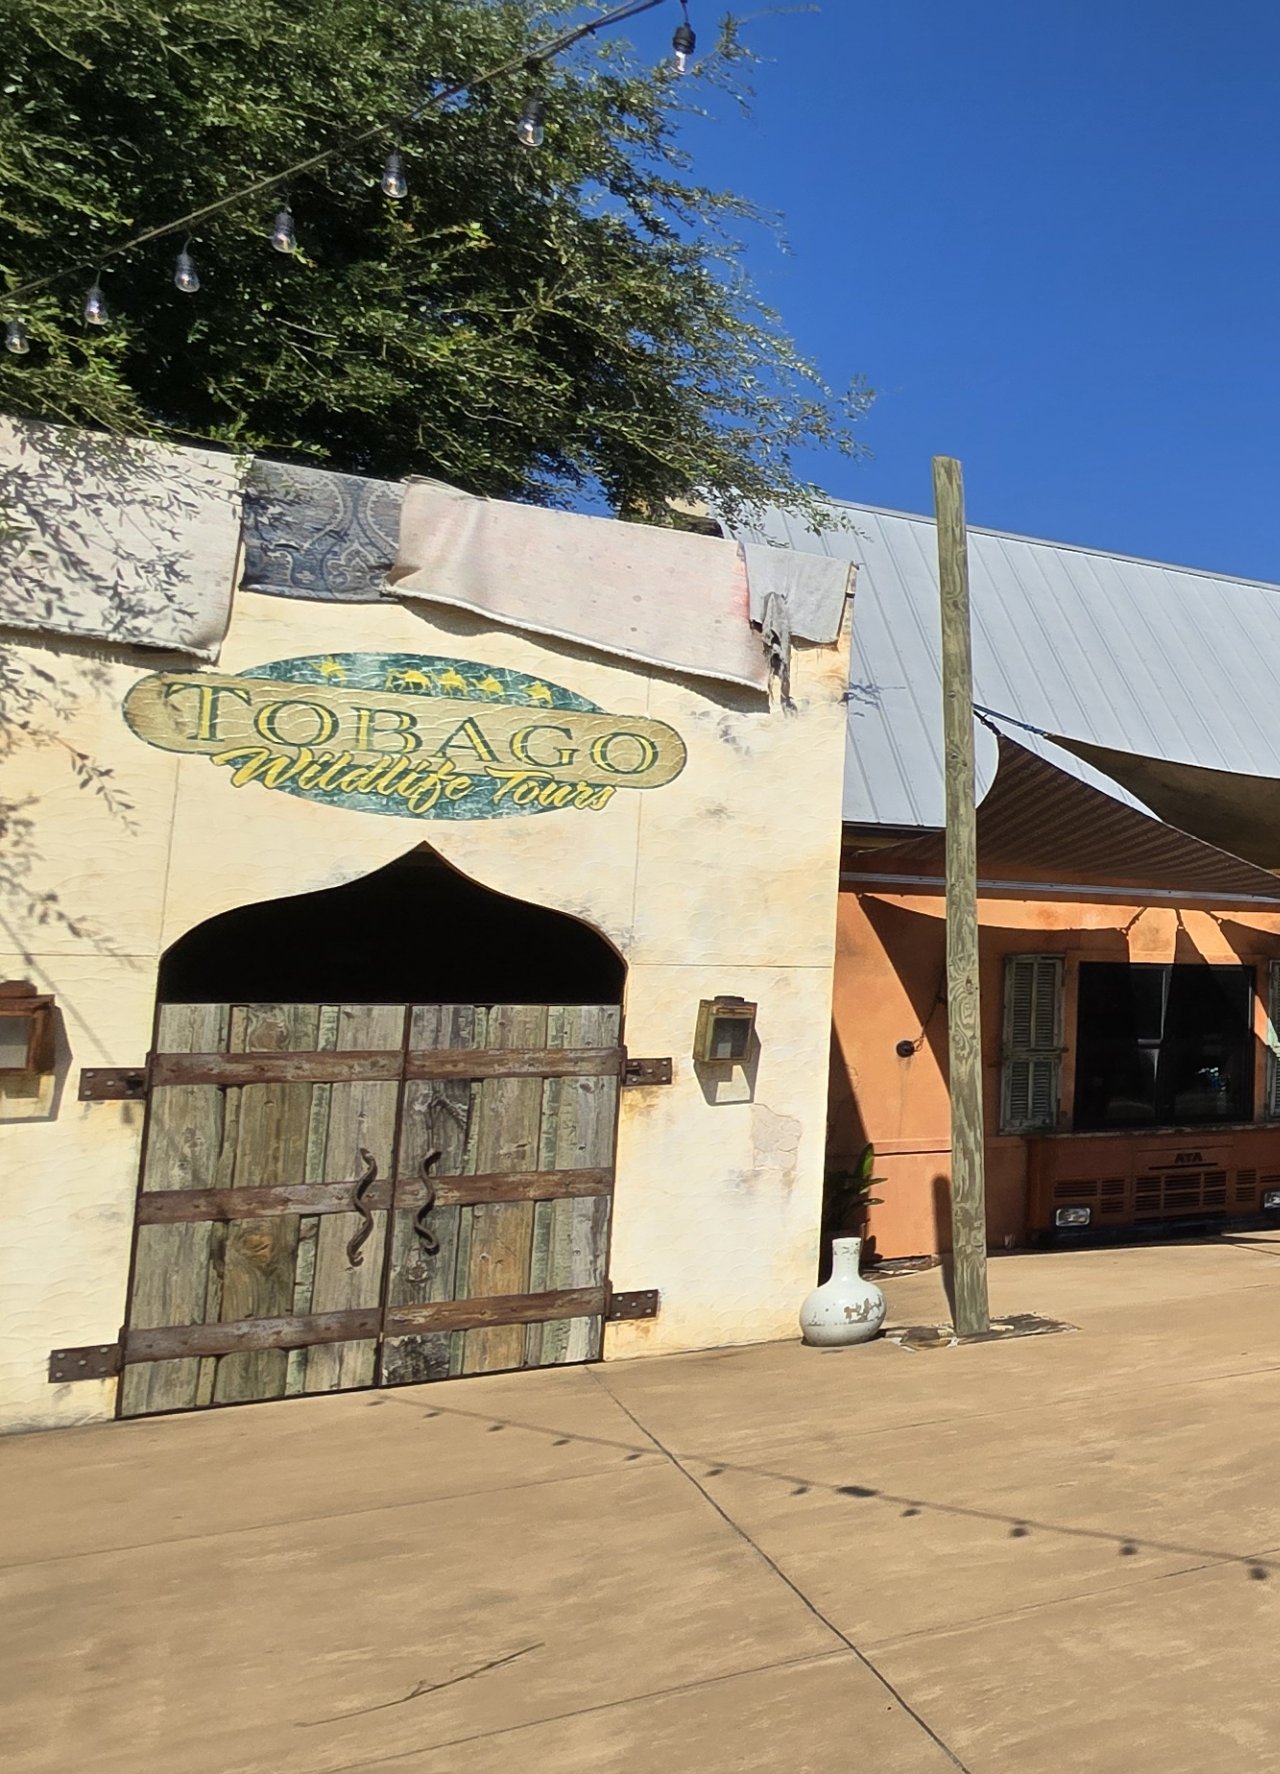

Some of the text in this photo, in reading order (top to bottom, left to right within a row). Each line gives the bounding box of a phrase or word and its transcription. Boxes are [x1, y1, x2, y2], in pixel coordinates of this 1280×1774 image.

[163, 681, 660, 776] TOBAGO
[210, 746, 616, 815] Wildlife Tours
